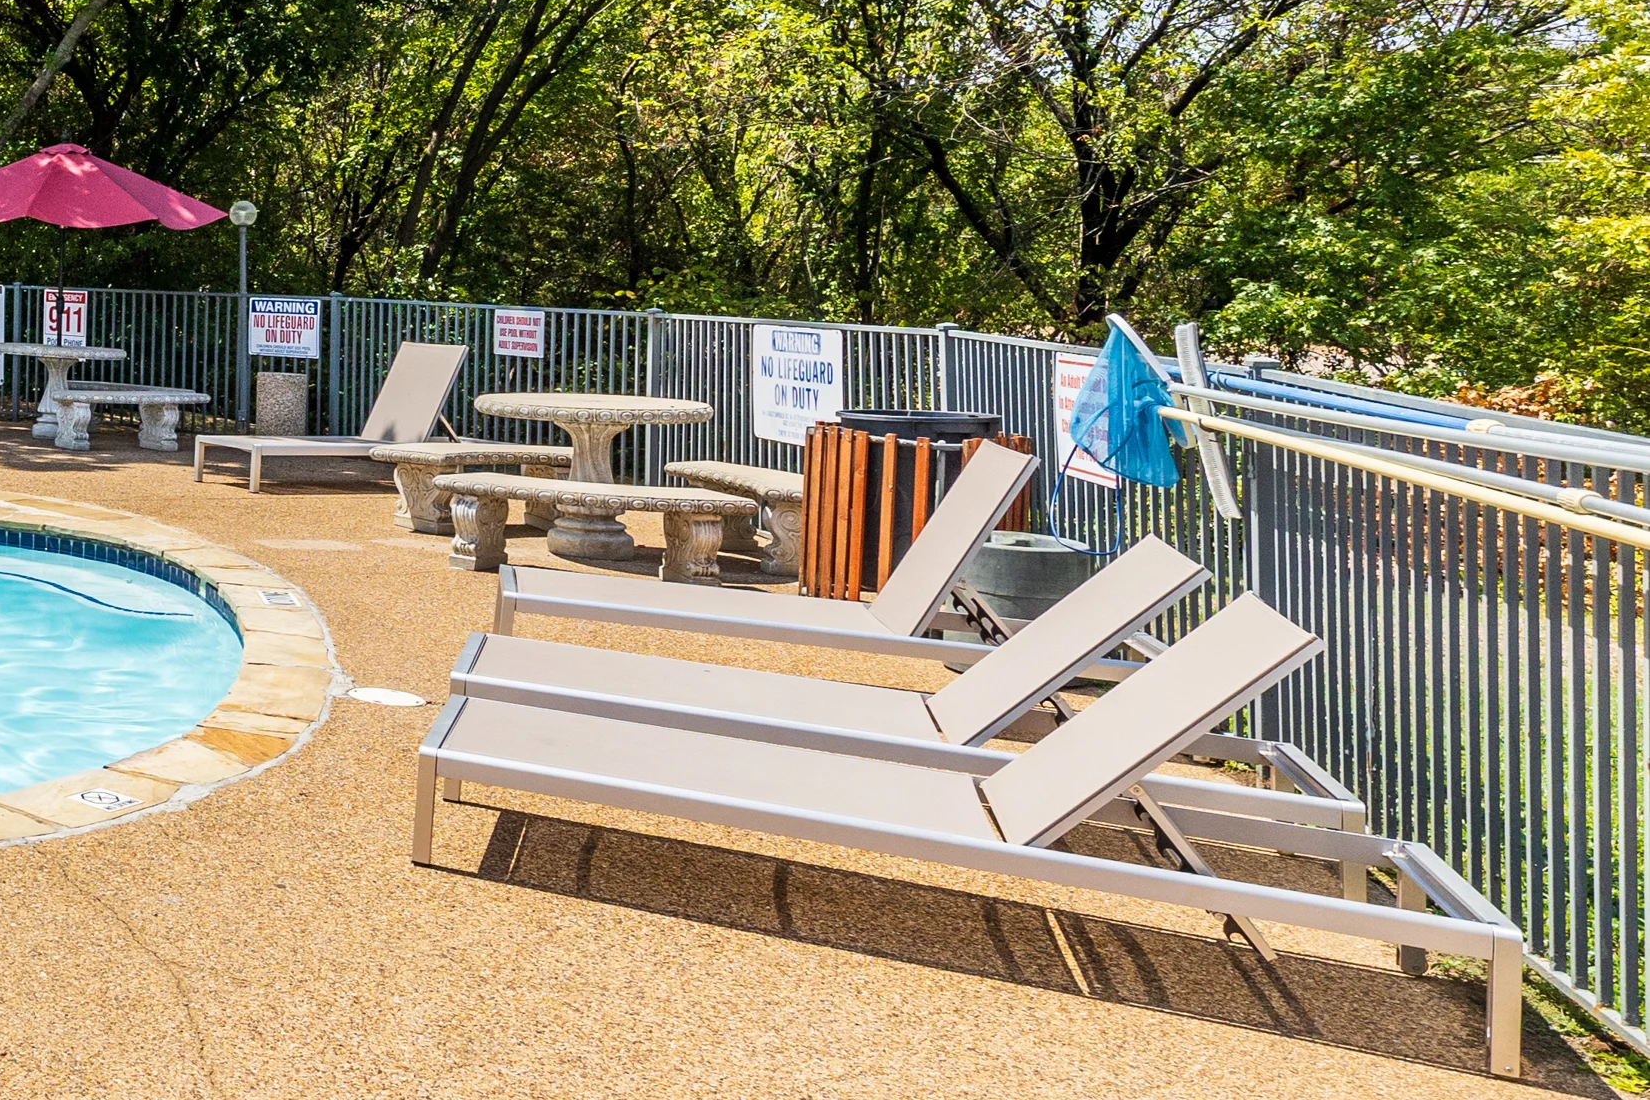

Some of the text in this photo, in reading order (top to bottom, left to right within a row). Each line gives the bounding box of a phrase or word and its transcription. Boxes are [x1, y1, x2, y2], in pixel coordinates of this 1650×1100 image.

[255, 301, 315, 313] WARNING
[49, 305, 82, 332] 911
[254, 315, 314, 330] NO LIFEGUARD
[497, 315, 541, 326] CHILDREN SHOULD NOT
[266, 329, 302, 344] ON DUTY
[508, 329, 518, 337] POOL
[519, 330, 537, 339] WITHOUT
[499, 340, 537, 352] ADULT SUPERVISION
[774, 332, 819, 354] WARNING
[761, 356, 833, 385] NO LIFEGUARD
[775, 384, 819, 411] ON DUTY
